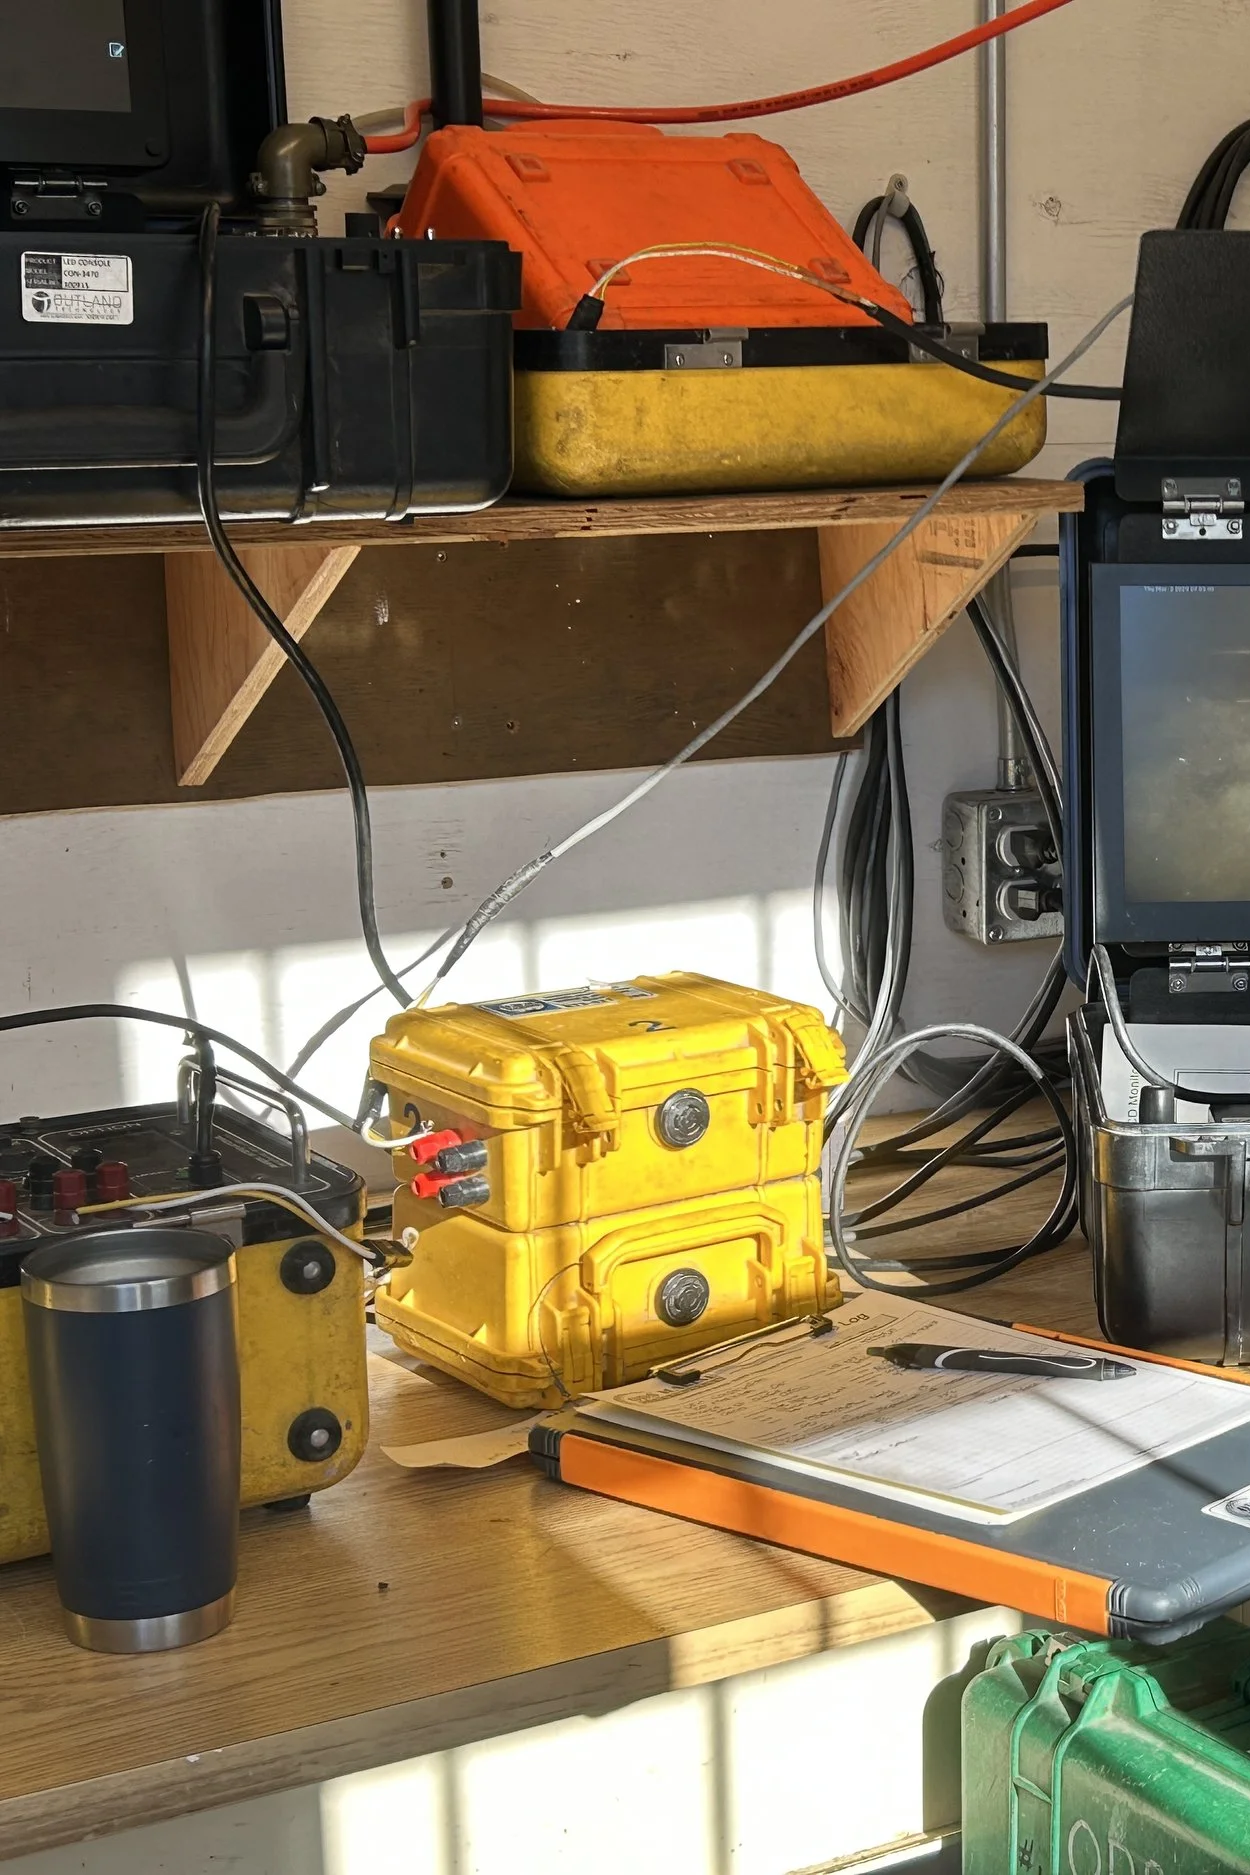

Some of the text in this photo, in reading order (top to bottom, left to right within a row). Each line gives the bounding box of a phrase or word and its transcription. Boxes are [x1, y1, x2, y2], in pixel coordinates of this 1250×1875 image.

[78, 259, 111, 267] CONSOLE
[53, 293, 122, 309] OUTLAND
[628, 1020, 677, 1033] 2
[67, 1121, 141, 1137] OPTION
[838, 1312, 870, 1327] Log
